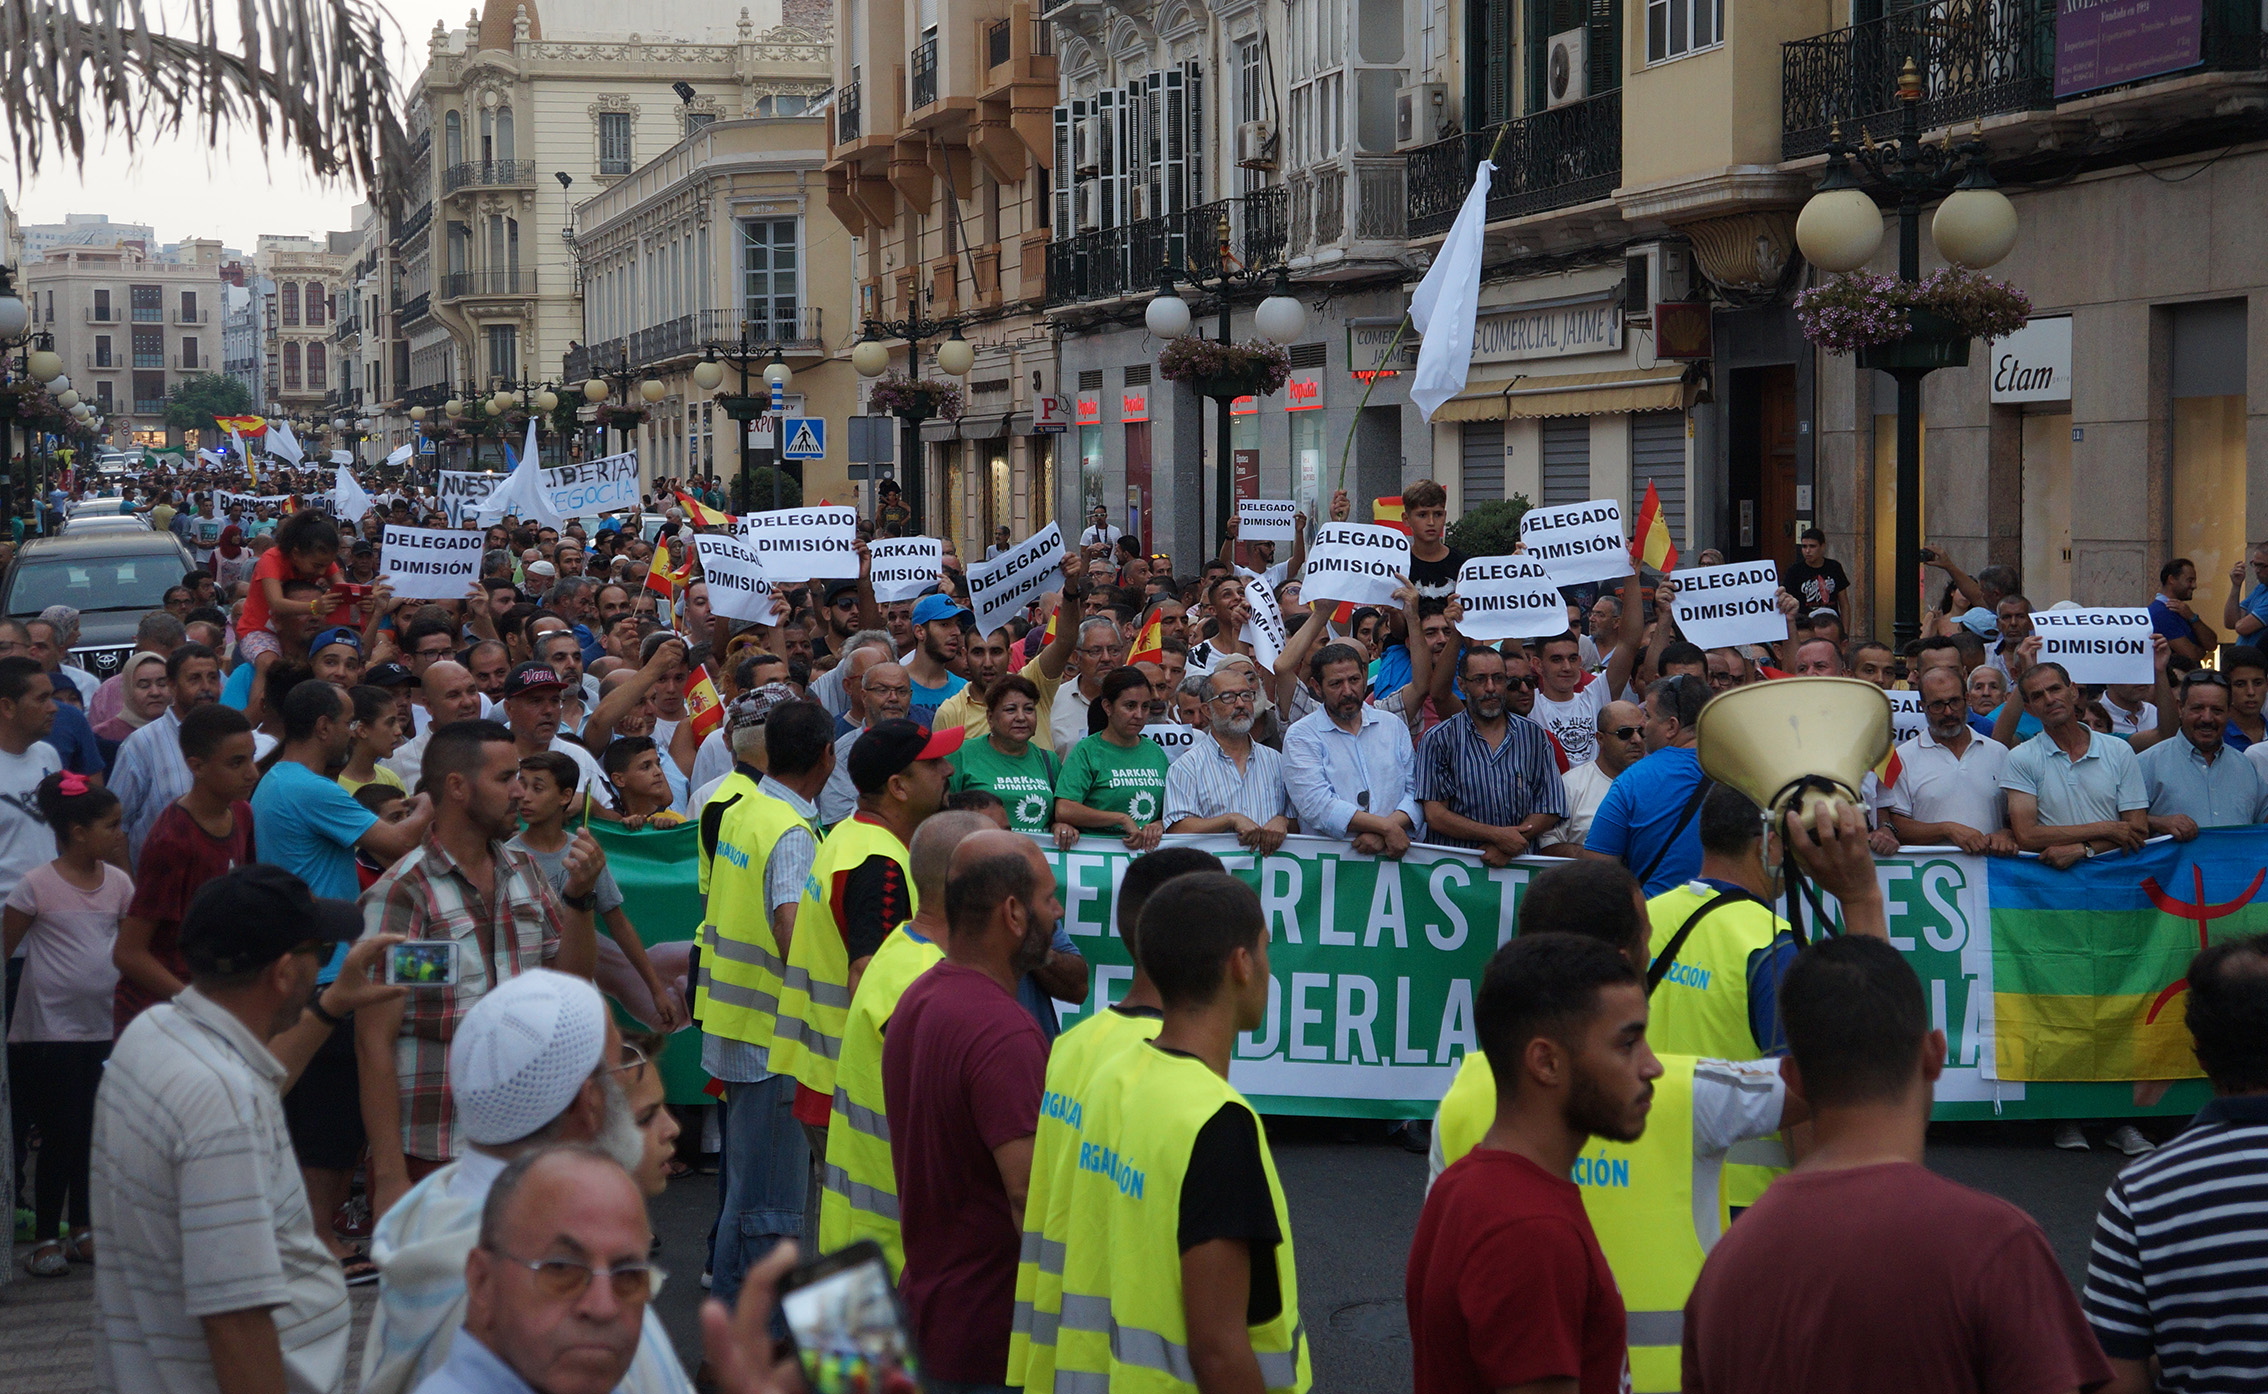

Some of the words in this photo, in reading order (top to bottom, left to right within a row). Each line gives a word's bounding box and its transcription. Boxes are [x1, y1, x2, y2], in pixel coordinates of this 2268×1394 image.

[1482, 313, 1557, 354] COMERCIAL
[1560, 308, 1605, 351] JAIME
[1994, 354, 2053, 392] Etam
[1289, 377, 1318, 403] Popular
[1042, 398, 1058, 419] P
[1240, 503, 1295, 512] DELEGADO
[750, 513, 855, 528] DELEGADO
[1243, 517, 1291, 526] DIMISIÓN
[385, 532, 482, 550] DELEGADO
[759, 536, 849, 552] DIMISIÓN
[1315, 530, 1409, 552] ELEGADO
[1527, 535, 1622, 560] DIMISIÓN
[871, 544, 936, 559] ARKANI
[390, 560, 473, 575] DIMISIÓN
[970, 532, 1061, 593] DELEGADO
[1307, 557, 1401, 577] DIMISIÓN
[872, 566, 938, 583] IMISIÓN
[1460, 591, 1557, 612] DIMISIÓN
[1680, 596, 1775, 622] DIMISIÓN
[2034, 614, 2149, 626] DELEGADO
[2047, 637, 2144, 654] DIMISIÓN
[996, 776, 1048, 786] BARKANI
[1111, 768, 1158, 779] BARKANI
